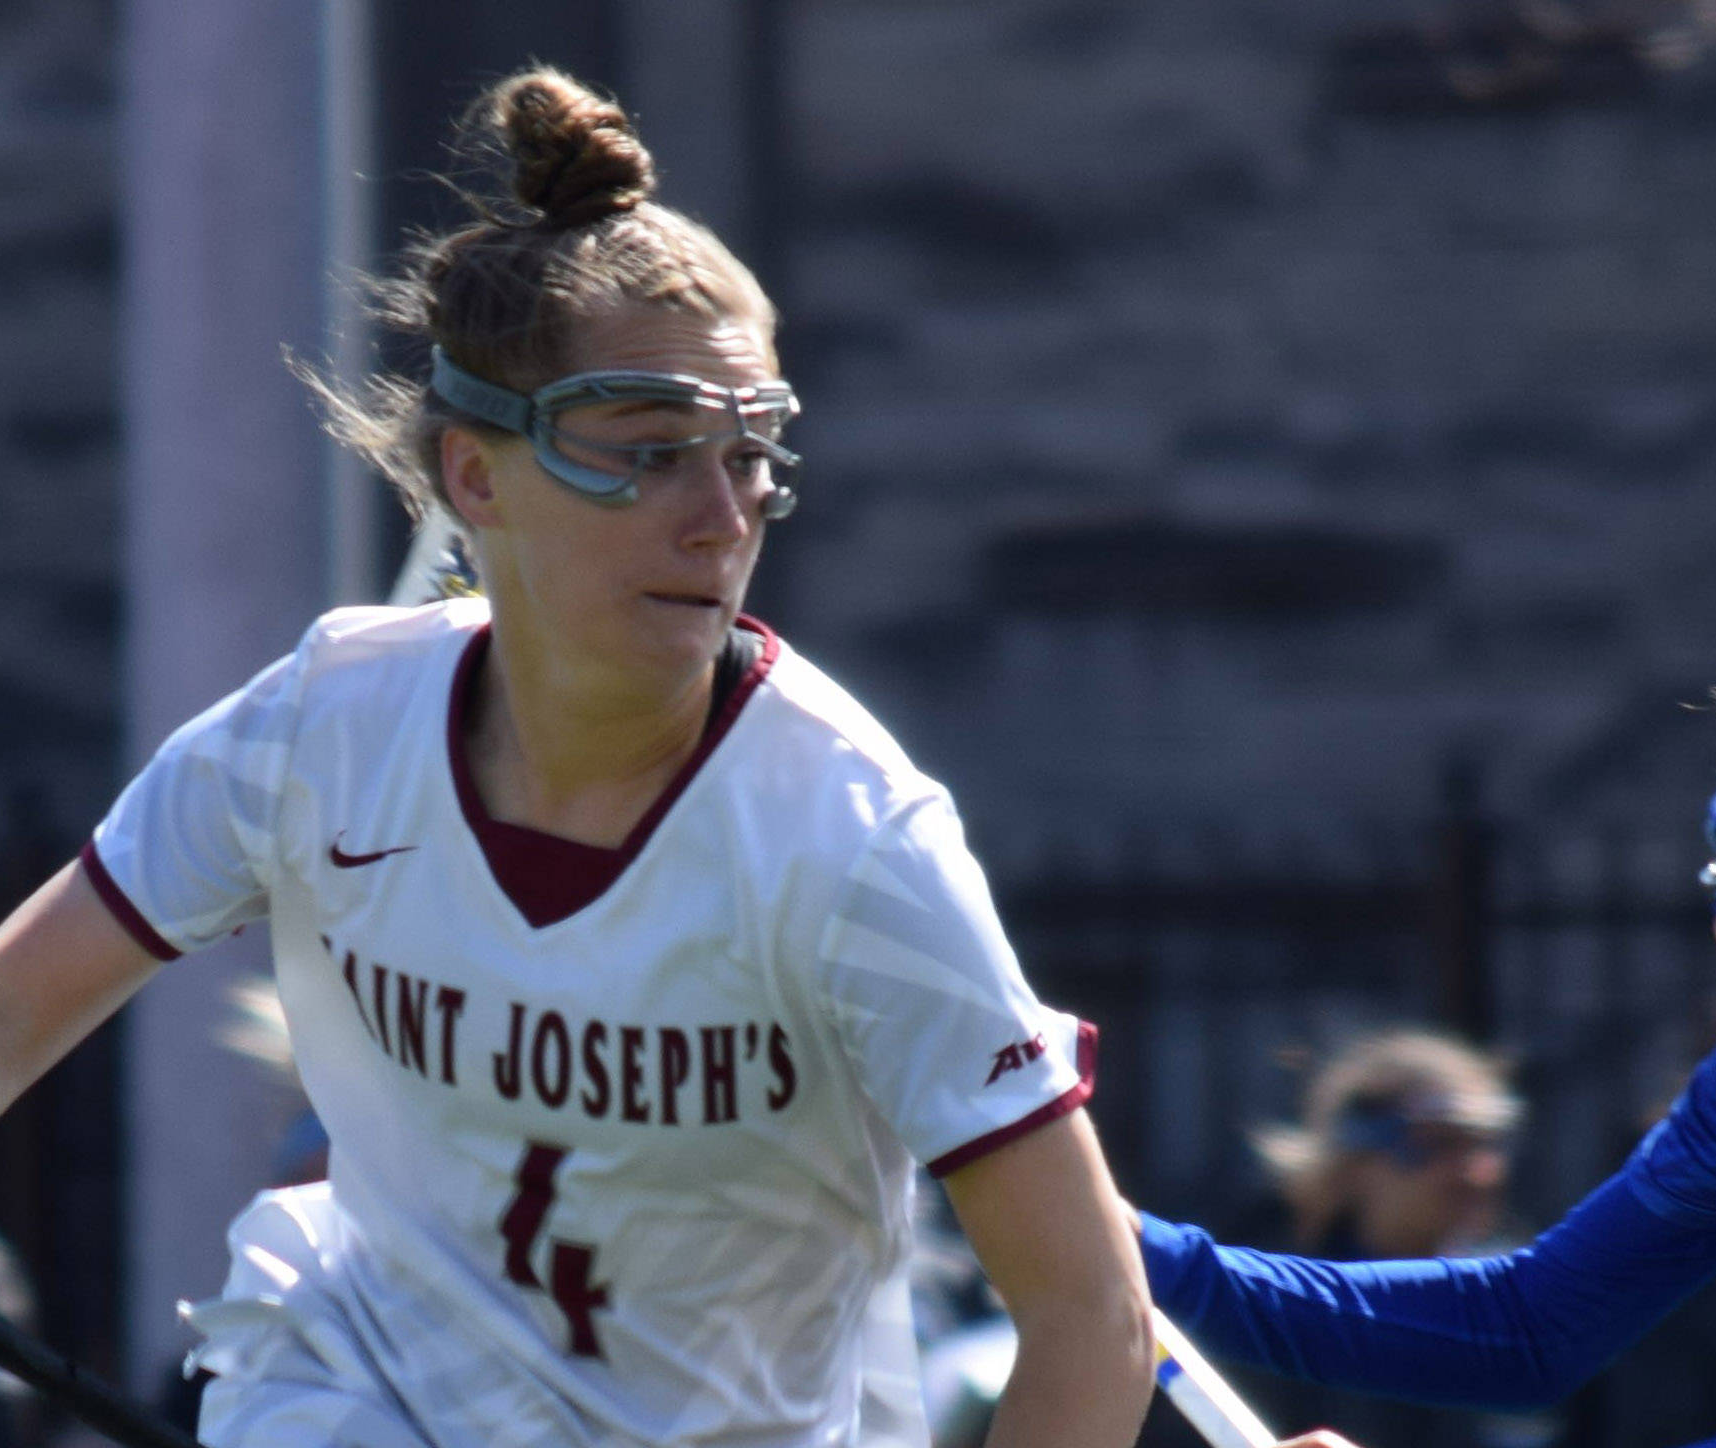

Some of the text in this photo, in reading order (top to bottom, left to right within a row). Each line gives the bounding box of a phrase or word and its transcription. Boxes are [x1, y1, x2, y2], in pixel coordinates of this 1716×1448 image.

[319, 933, 799, 1127] AINT JOSEPH'S
[498, 1138, 612, 1365] 4
